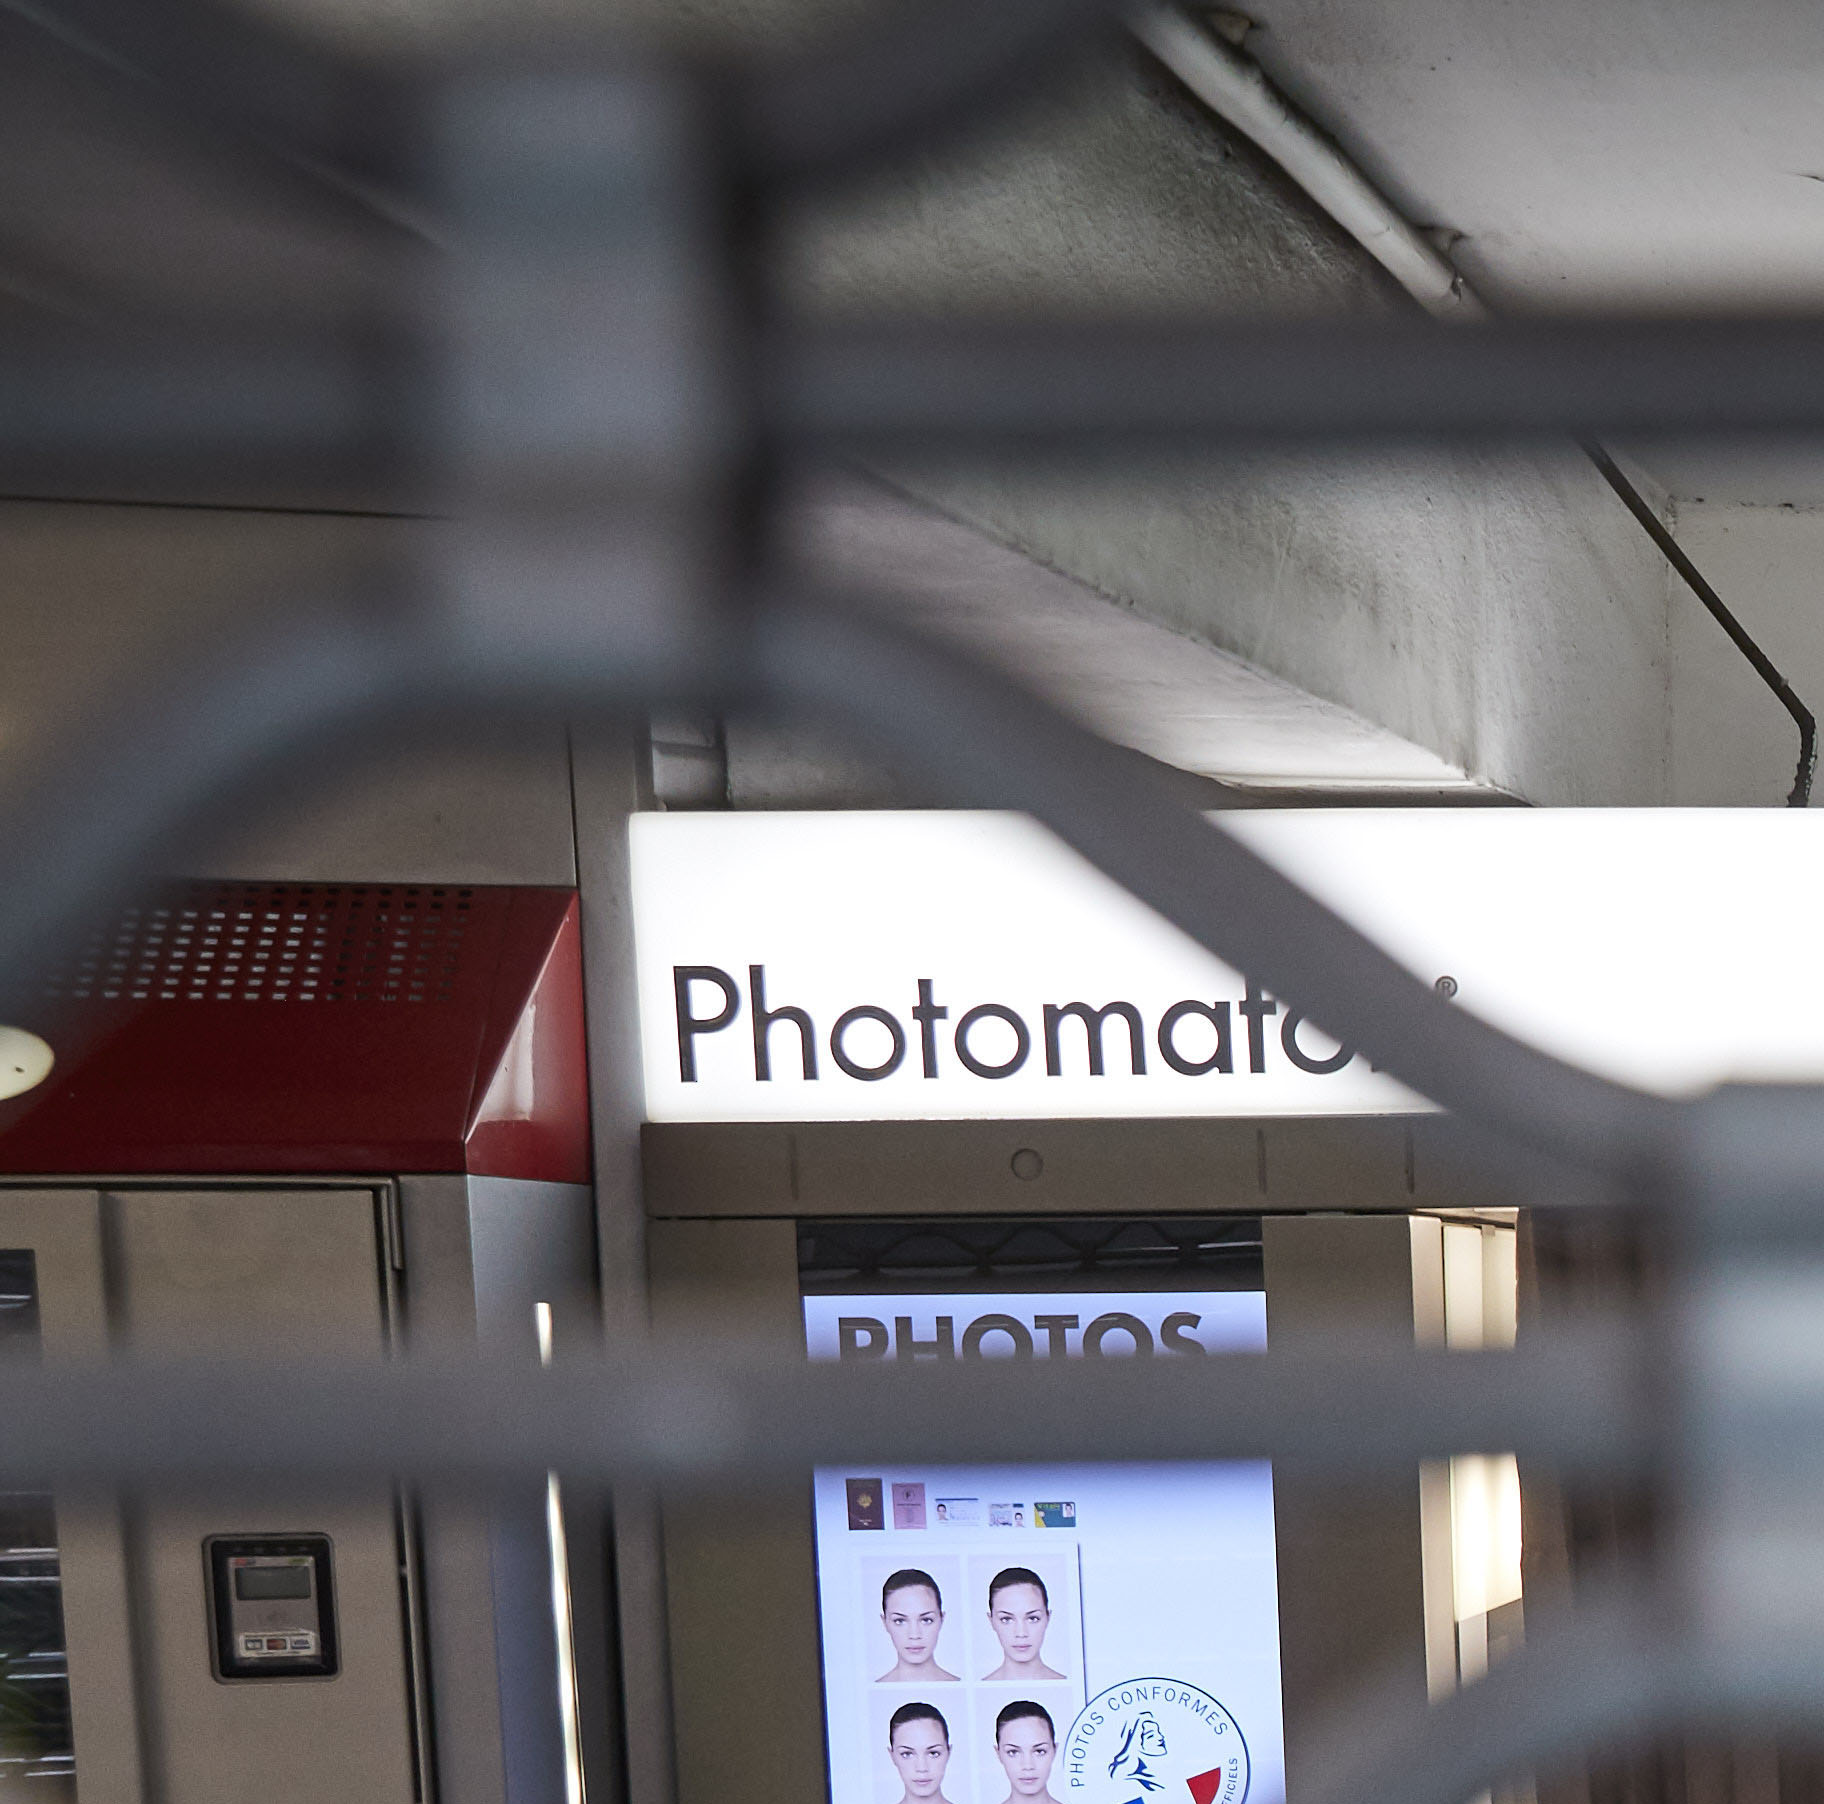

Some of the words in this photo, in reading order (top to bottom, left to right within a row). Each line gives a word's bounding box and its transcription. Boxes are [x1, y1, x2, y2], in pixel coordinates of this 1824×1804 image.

[672, 964, 1400, 1083] Photomato
[838, 1311, 1206, 1362] PHOTOS
[1070, 1711, 1105, 1788] PHOTOS
[1108, 1686, 1228, 1736] CONFORMES
